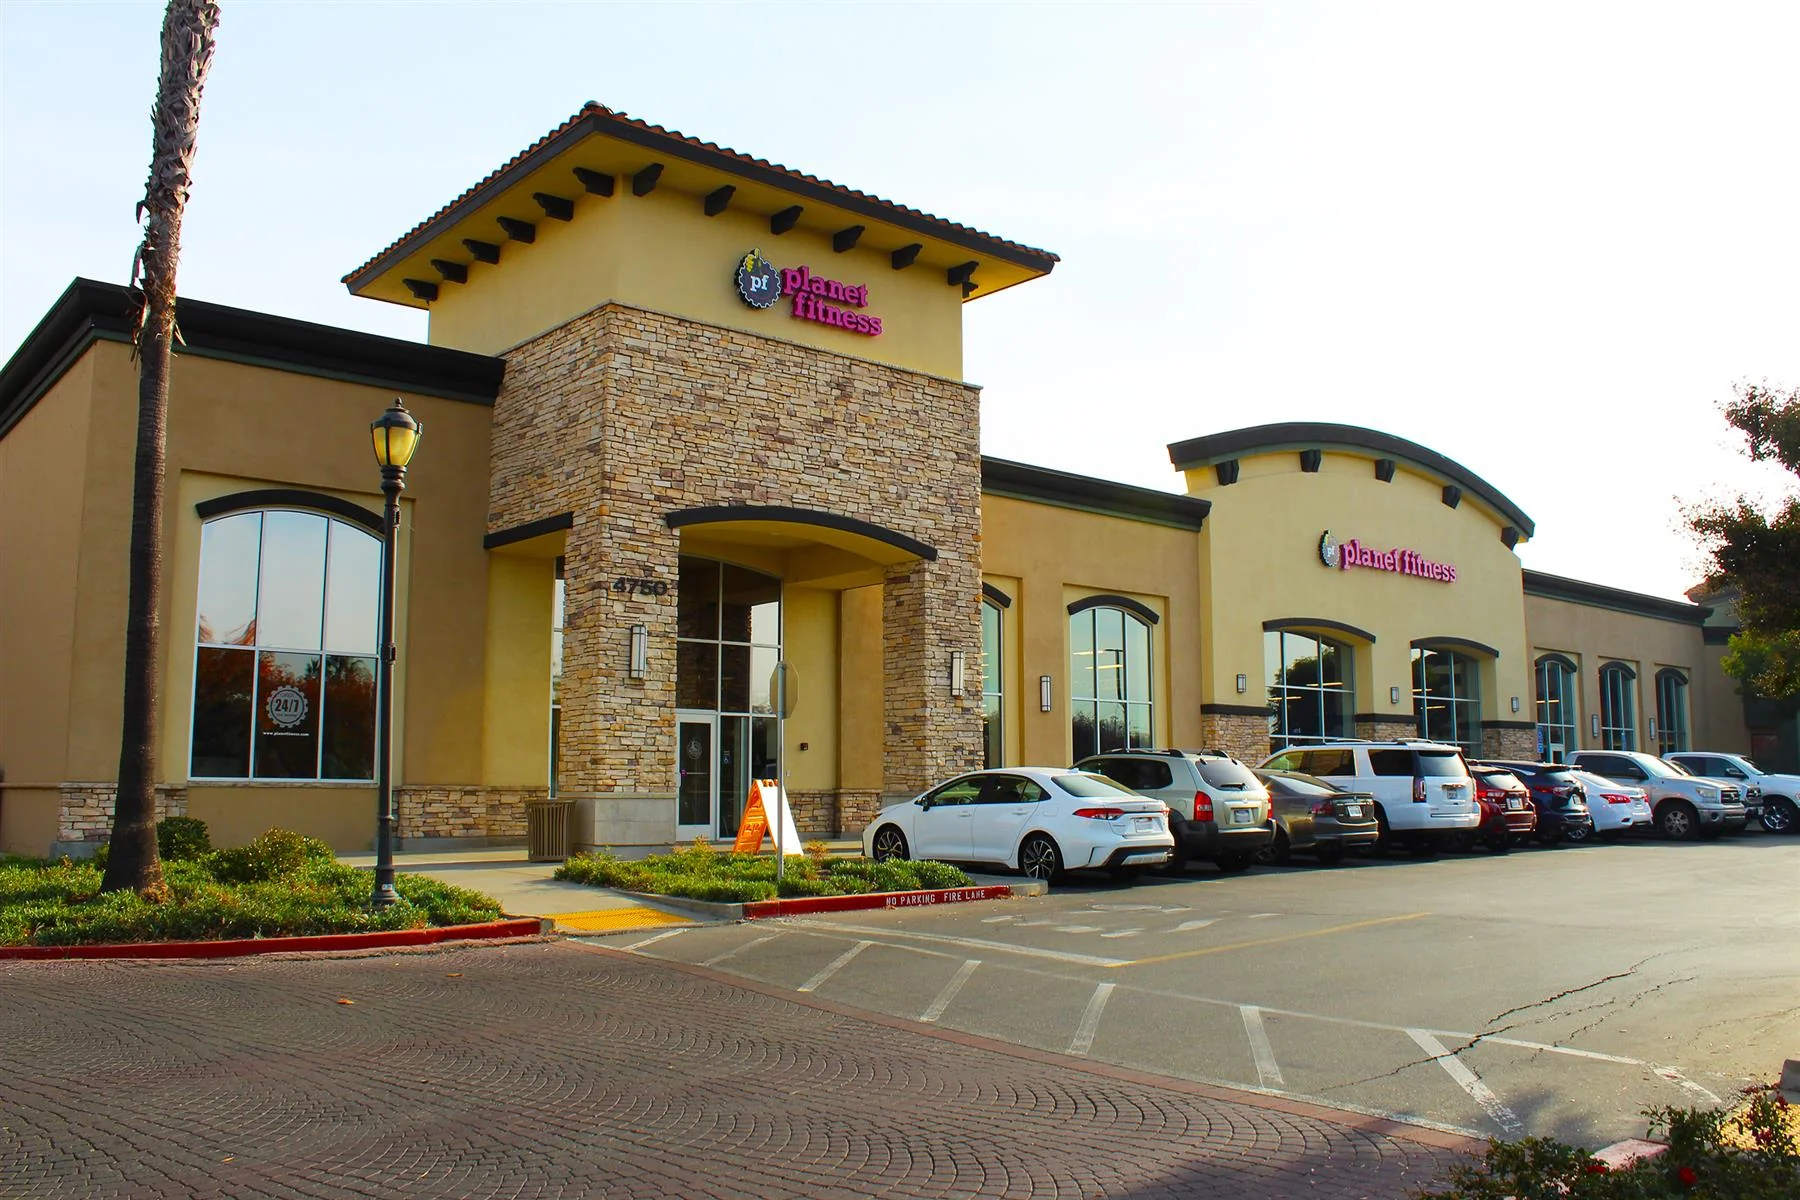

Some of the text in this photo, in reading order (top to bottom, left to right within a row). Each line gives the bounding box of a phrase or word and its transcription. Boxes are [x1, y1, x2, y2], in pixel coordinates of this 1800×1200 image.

[750, 275, 769, 292] pf
[781, 266, 868, 308] planet
[792, 291, 883, 336] fitness
[1340, 539, 1457, 583] planet fitness
[613, 577, 668, 595] 4750
[275, 699, 300, 712] 24/7
[886, 889, 986, 906] NO PARKING FIRE LANE
